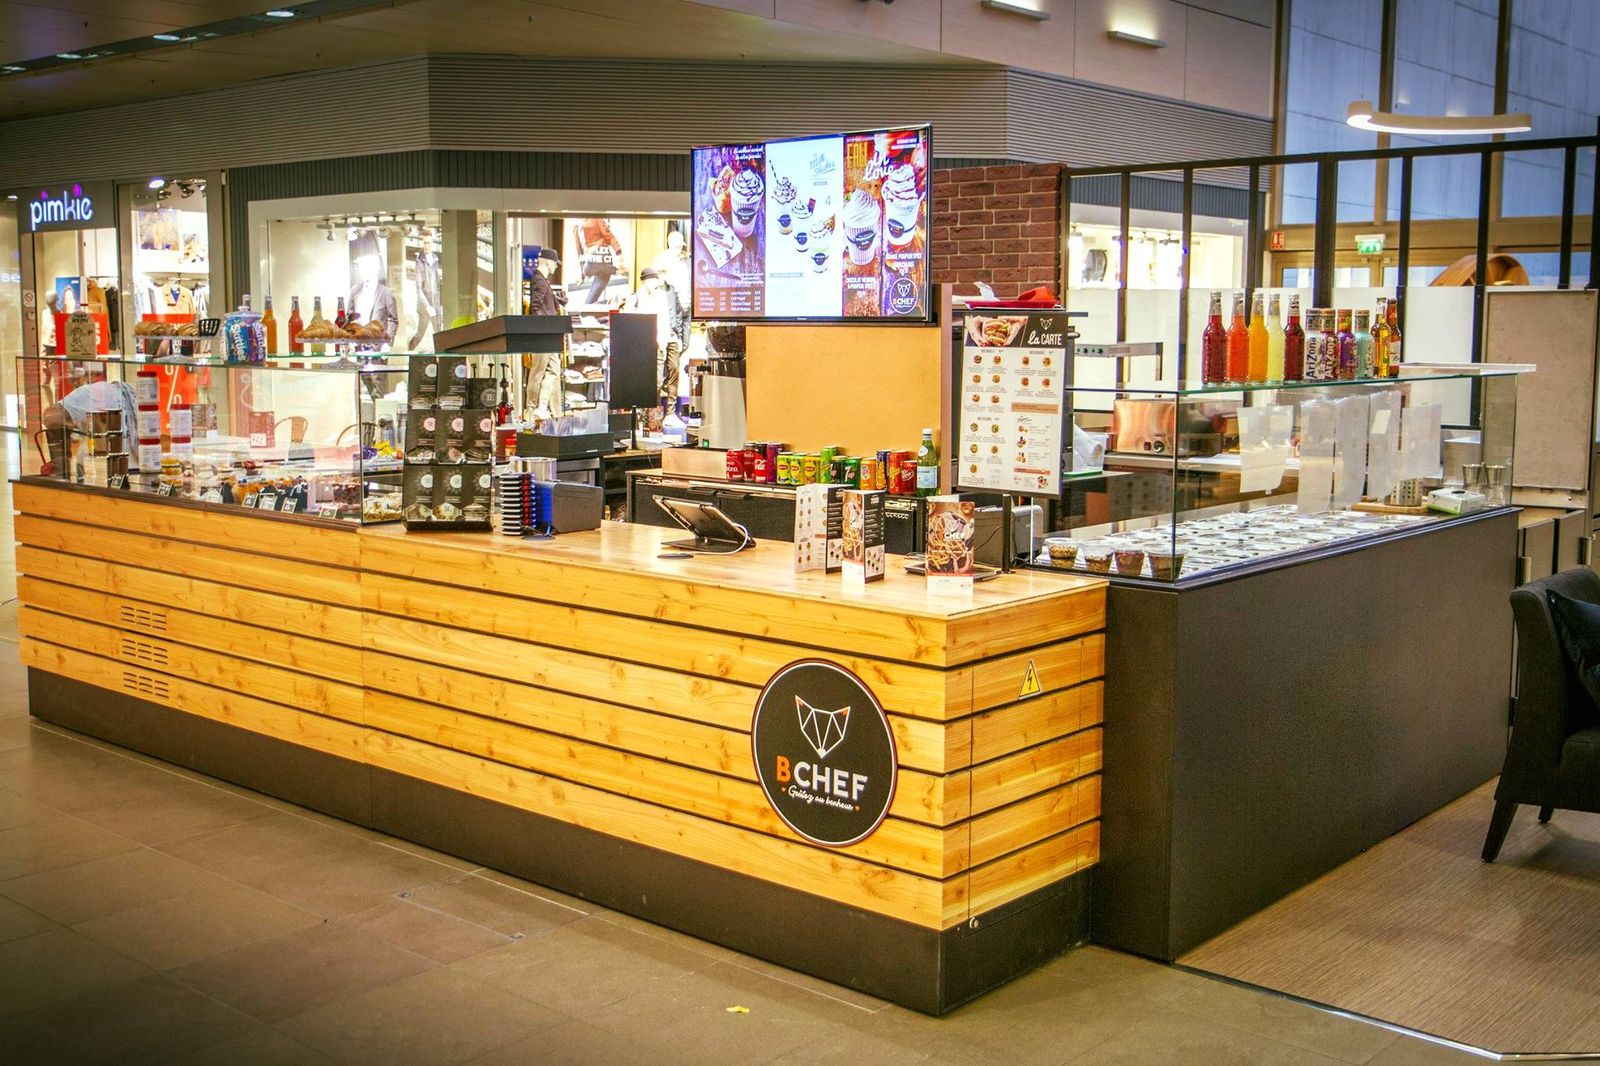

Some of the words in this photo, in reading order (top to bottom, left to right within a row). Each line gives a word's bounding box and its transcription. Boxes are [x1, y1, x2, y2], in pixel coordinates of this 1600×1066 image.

[30, 183, 93, 231] pimkie
[230, 323, 246, 361] Skittles
[1027, 330, 1040, 345] la
[1040, 333, 1063, 346] CARTE
[1305, 337, 1317, 379] AriZona
[776, 755, 869, 801] BCHEF
[826, 796, 854, 811] bonheur
